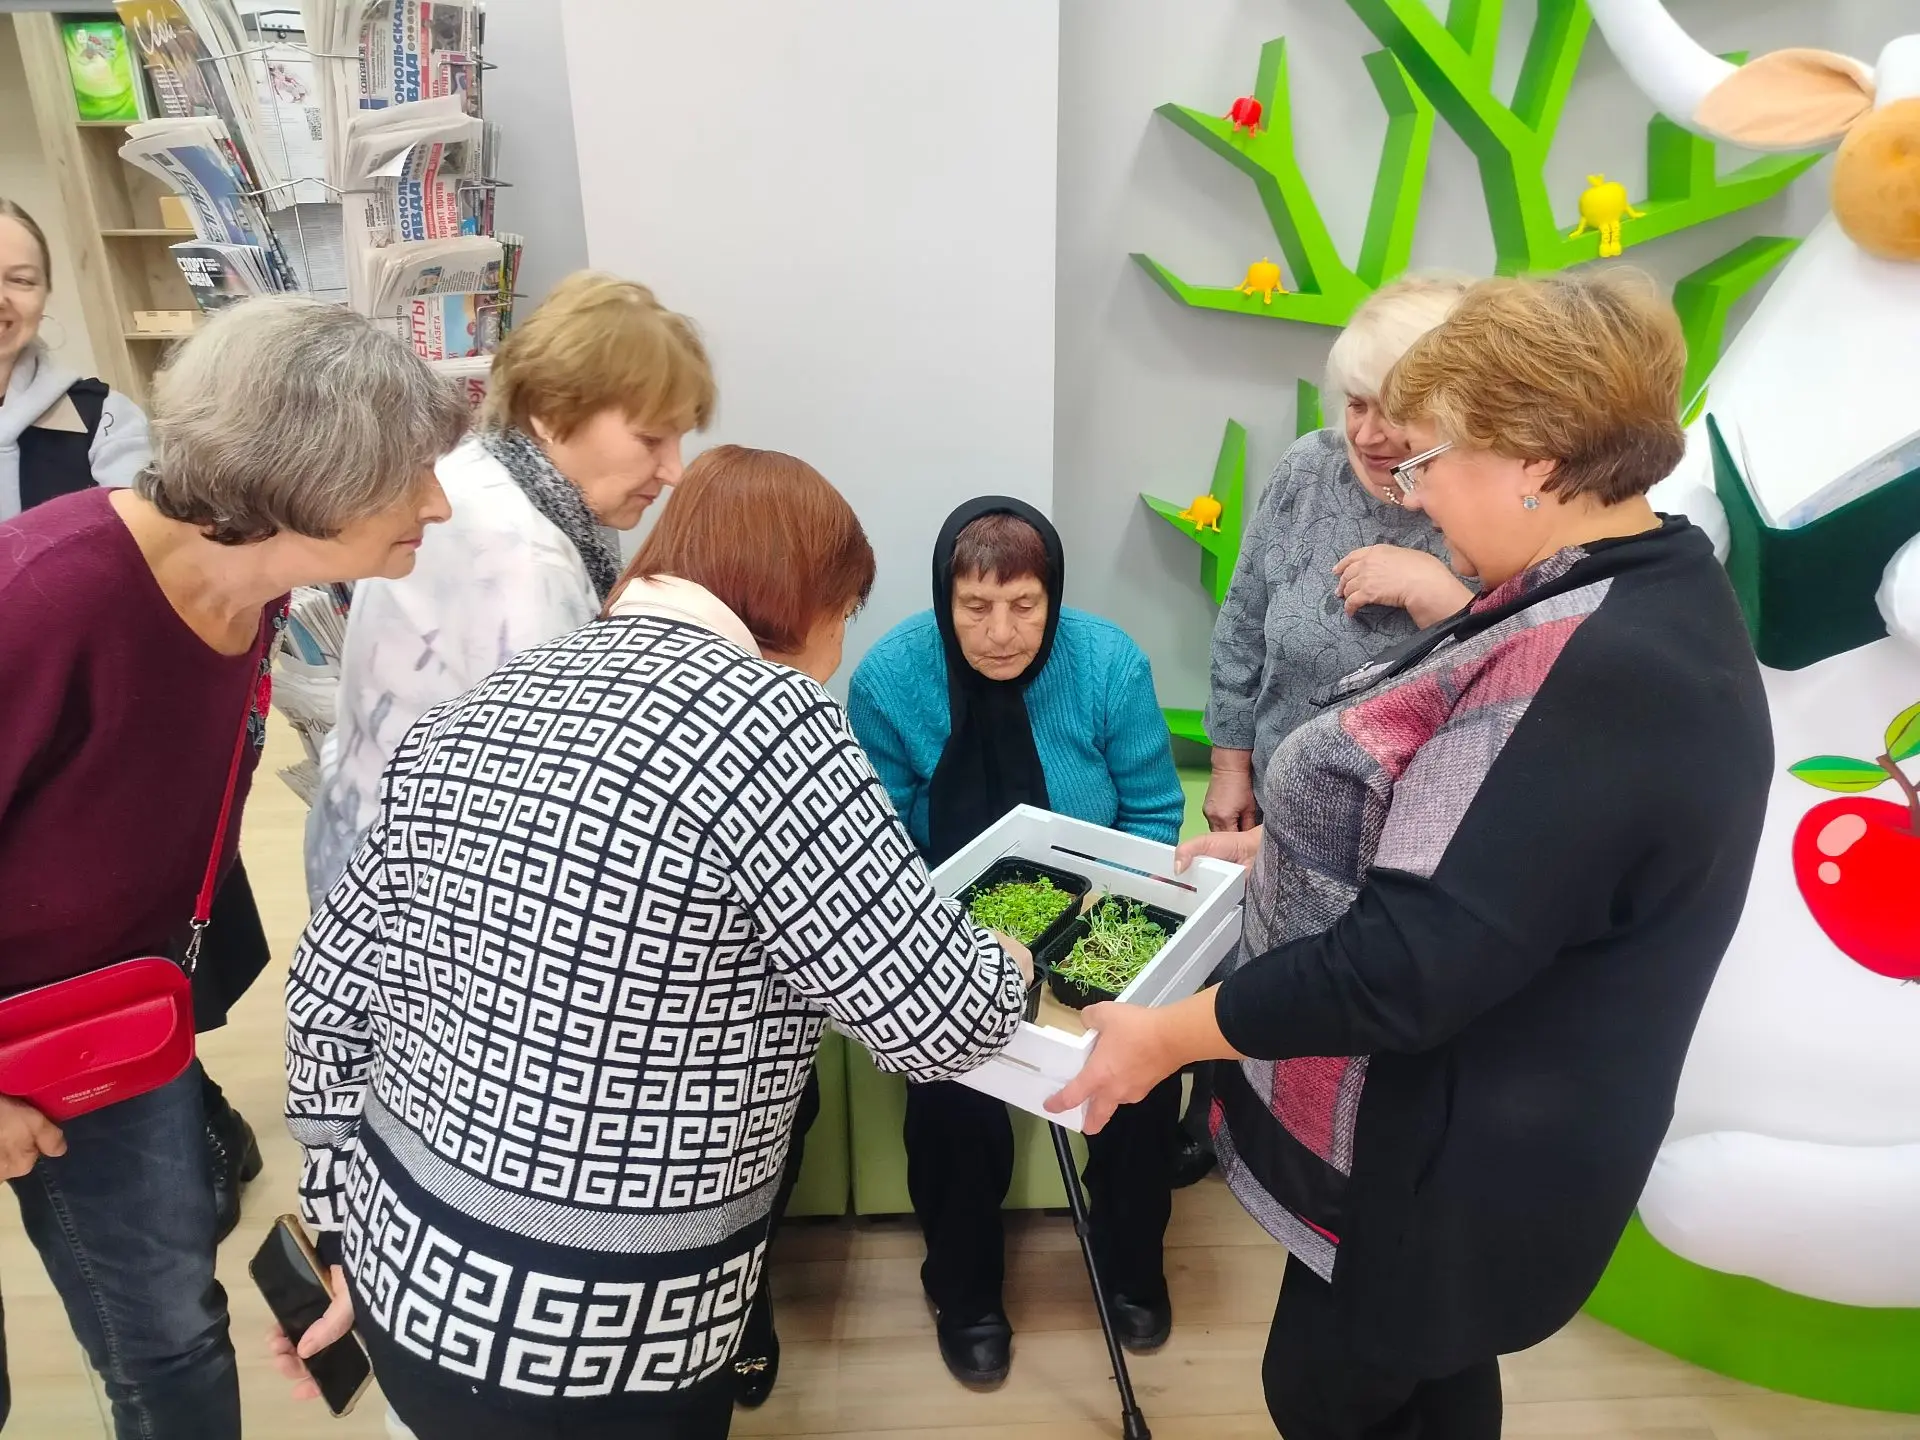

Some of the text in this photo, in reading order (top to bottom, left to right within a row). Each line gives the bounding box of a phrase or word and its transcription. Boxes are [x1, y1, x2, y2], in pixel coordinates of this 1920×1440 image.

[393, 0, 405, 106] ОМОЛЬСКАЯ
[446, 192, 458, 225] Москве
[433, 315, 442, 344] ГАЗЕТА
